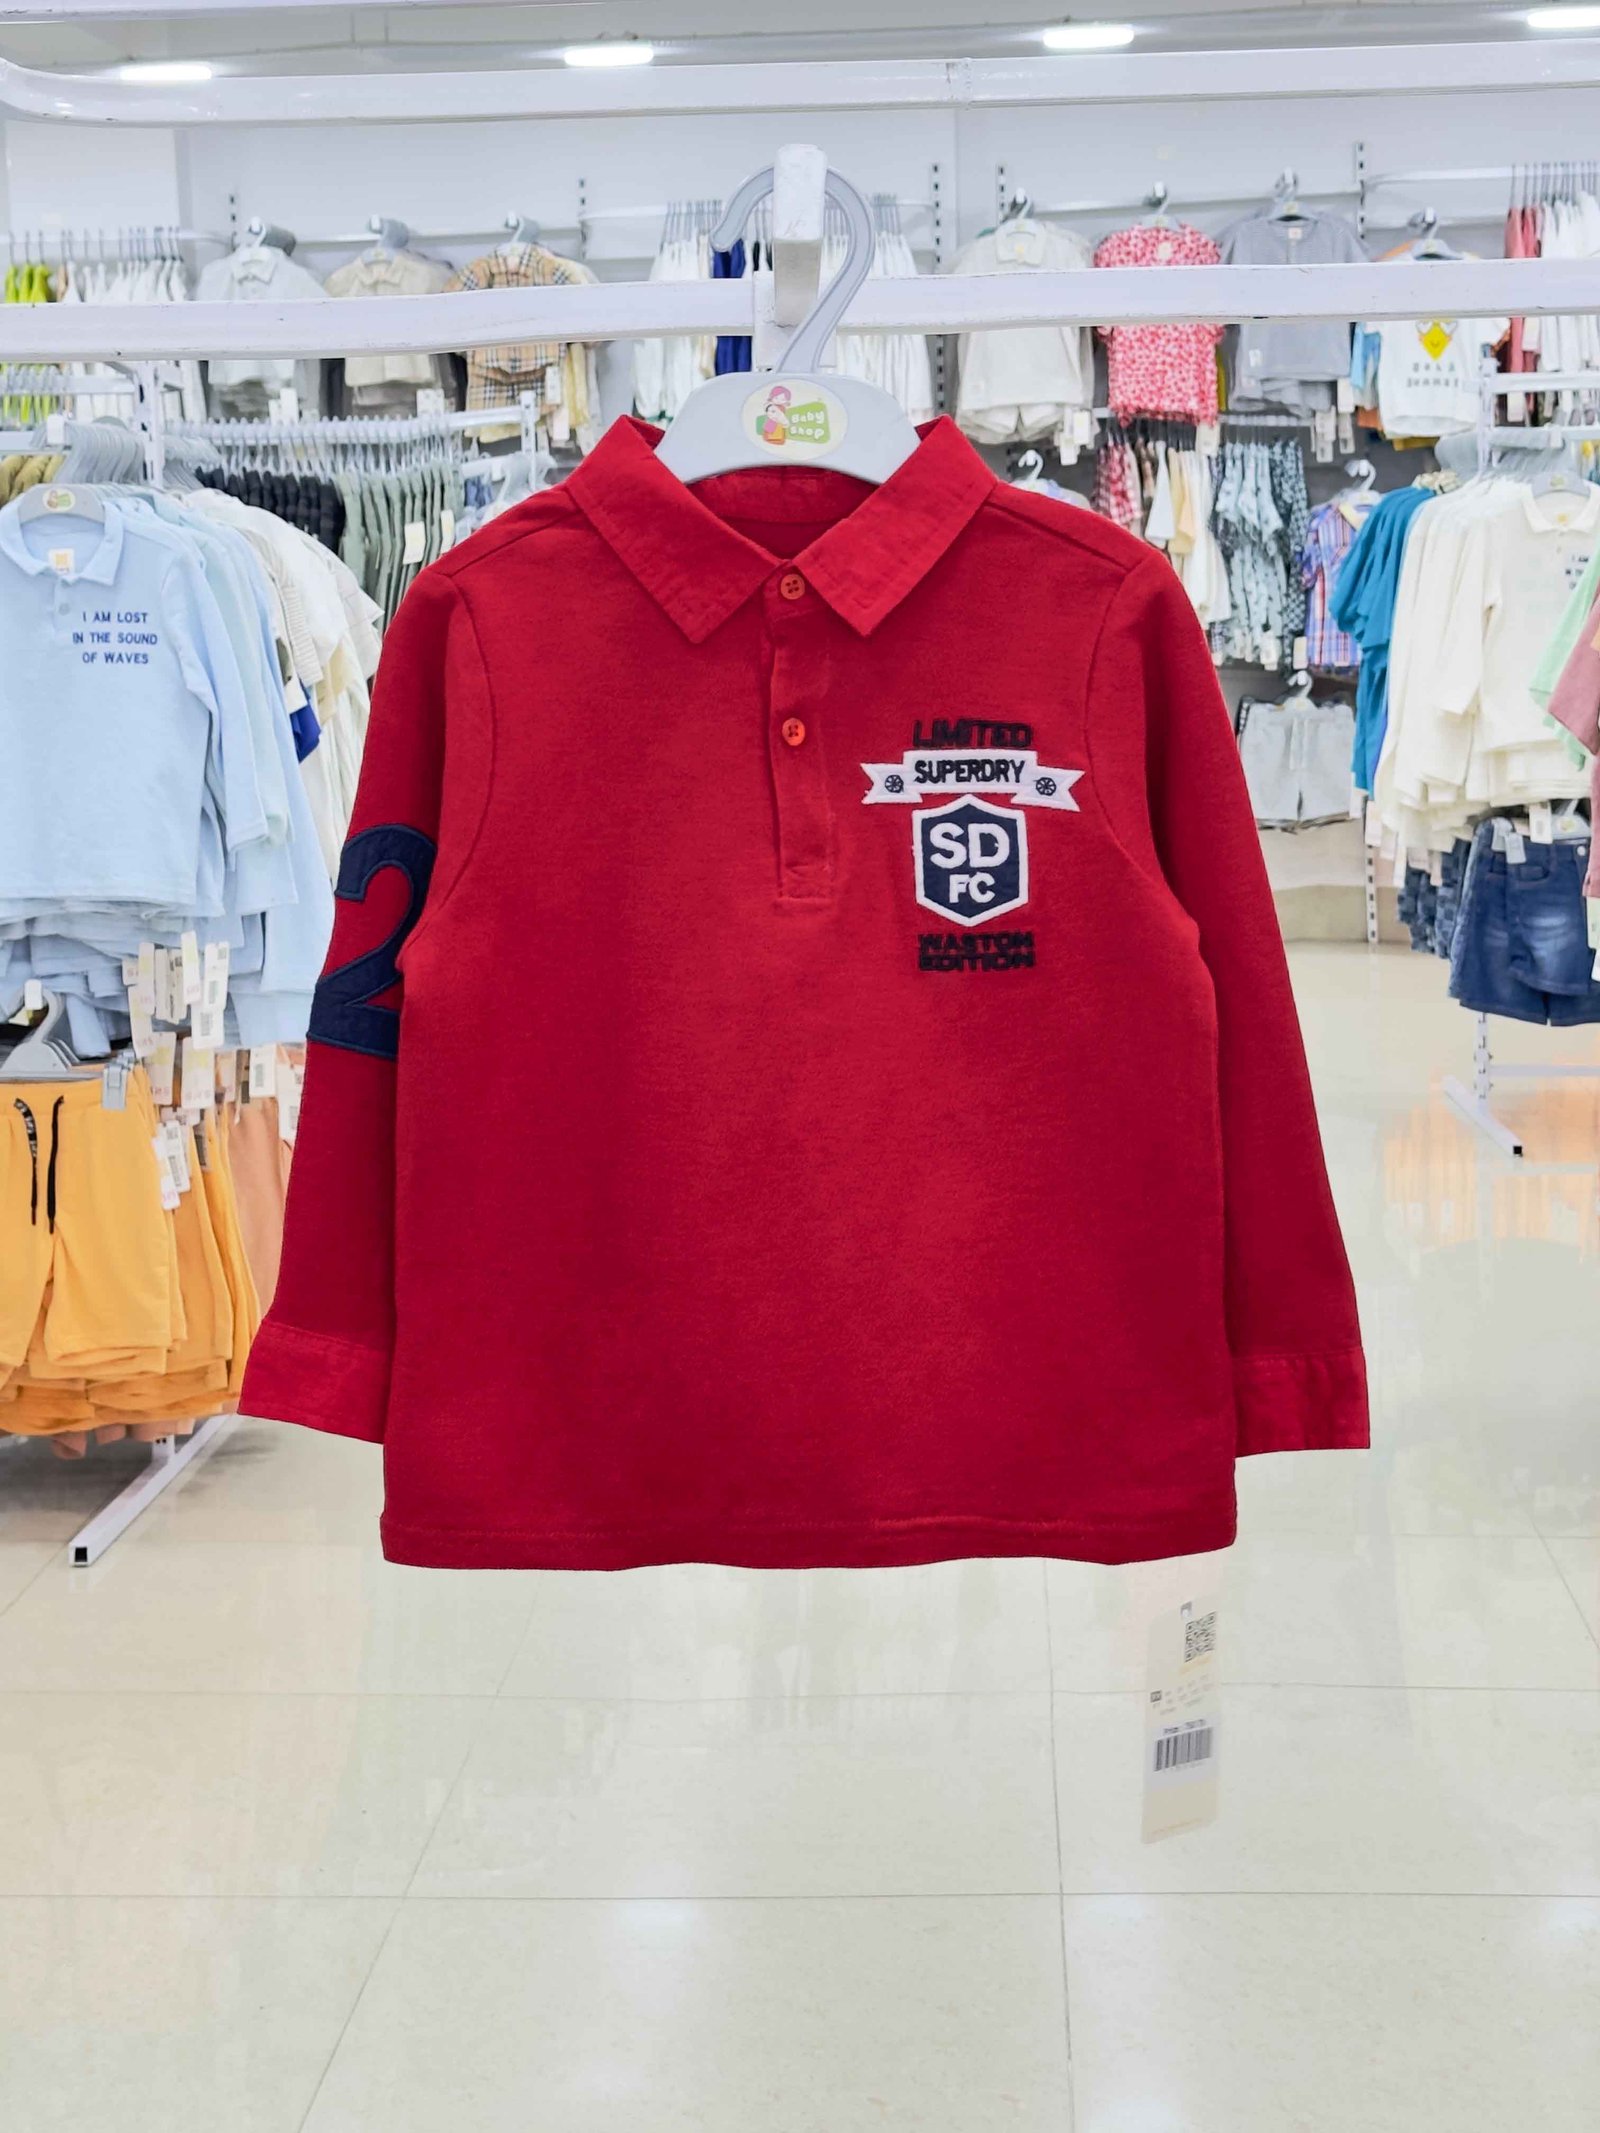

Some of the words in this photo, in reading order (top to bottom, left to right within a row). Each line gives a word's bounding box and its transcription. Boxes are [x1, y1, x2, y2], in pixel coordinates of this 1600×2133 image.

[82, 611, 87, 622] I
[93, 611, 111, 622] AM
[117, 611, 148, 623] LOST
[72, 632, 84, 644] IN
[90, 632, 110, 643] THE
[117, 632, 158, 645] SOUND
[82, 651, 97, 663] OF
[103, 651, 149, 664] WAVES
[914, 758, 1026, 784] SUPERDRY
[929, 822, 1010, 869] SD
[949, 871, 996, 904] FC
[306, 824, 437, 1061] 2
